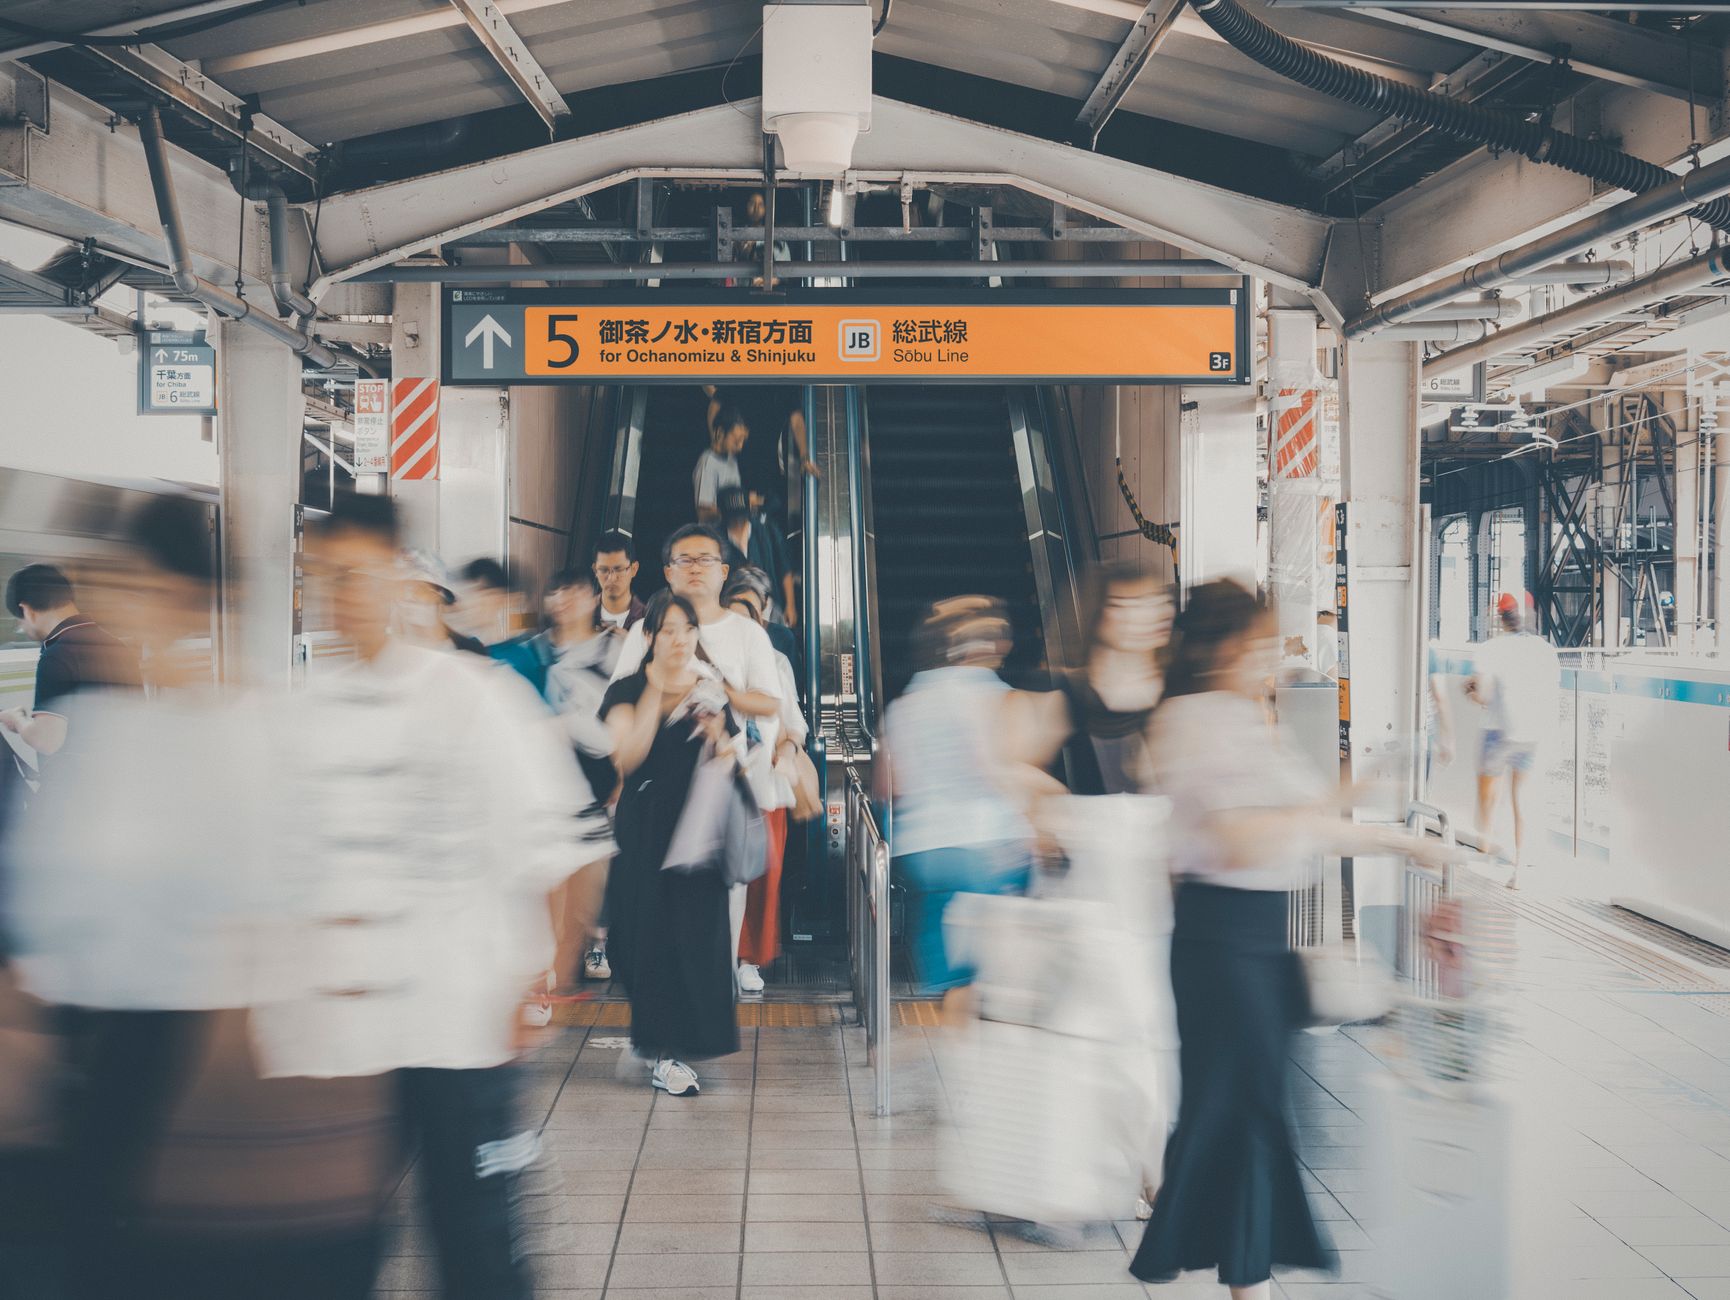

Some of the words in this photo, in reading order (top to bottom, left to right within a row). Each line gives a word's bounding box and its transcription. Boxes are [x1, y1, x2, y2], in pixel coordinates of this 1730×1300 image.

[598, 319, 813, 345] 御茶ノ水・新宿方面
[892, 319, 968, 344] 総武線
[547, 314, 580, 369] 5
[848, 332, 870, 349] JB
[172, 350, 198, 362] 75m
[599, 349, 622, 363] for
[626, 348, 725, 363] Ochanomizu
[730, 349, 742, 363] &
[746, 348, 816, 366] Shinjuku
[893, 348, 932, 363] Sōbu
[937, 348, 969, 363] Line
[1212, 353, 1230, 369] 3F
[359, 384, 384, 393] STOP
[1430, 378, 1439, 390] 6
[170, 391, 179, 403] 6
